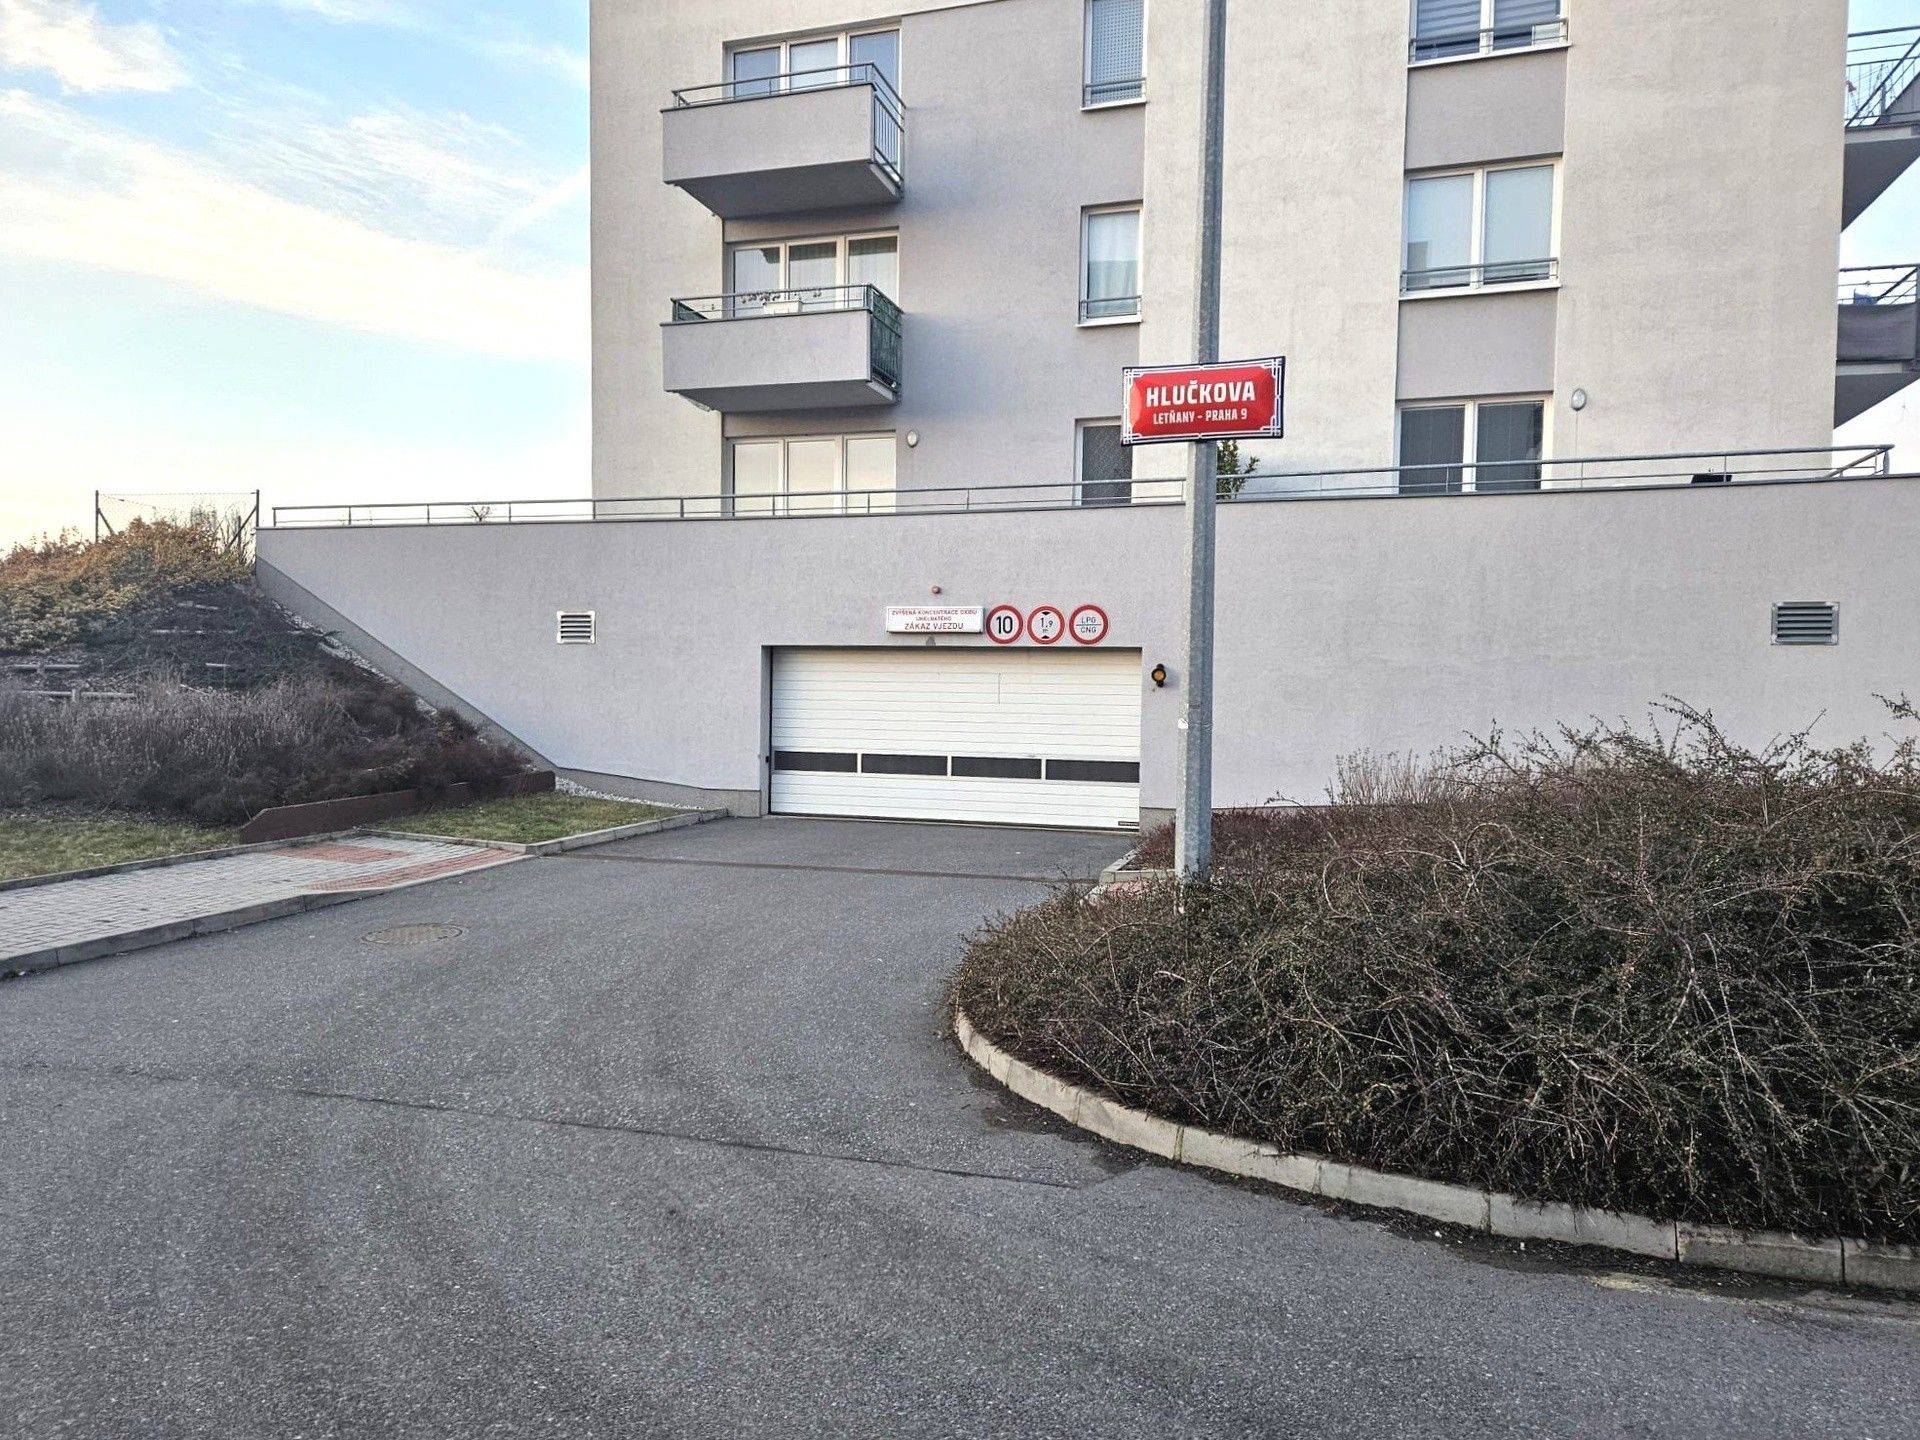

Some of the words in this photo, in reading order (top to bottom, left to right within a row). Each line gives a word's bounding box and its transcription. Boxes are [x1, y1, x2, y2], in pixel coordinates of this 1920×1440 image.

[1146, 380, 1256, 408] HLUČKOVA
[1153, 410, 1195, 425] LETŇANY
[1205, 409, 1238, 421] PRAHA
[1241, 408, 1248, 420] 9
[904, 622, 930, 630] ZÁKAZ
[933, 622, 964, 630] VJEZDU
[996, 615, 1013, 634] 10
[1081, 616, 1096, 624] LPG
[1080, 626, 1097, 634] CNG
